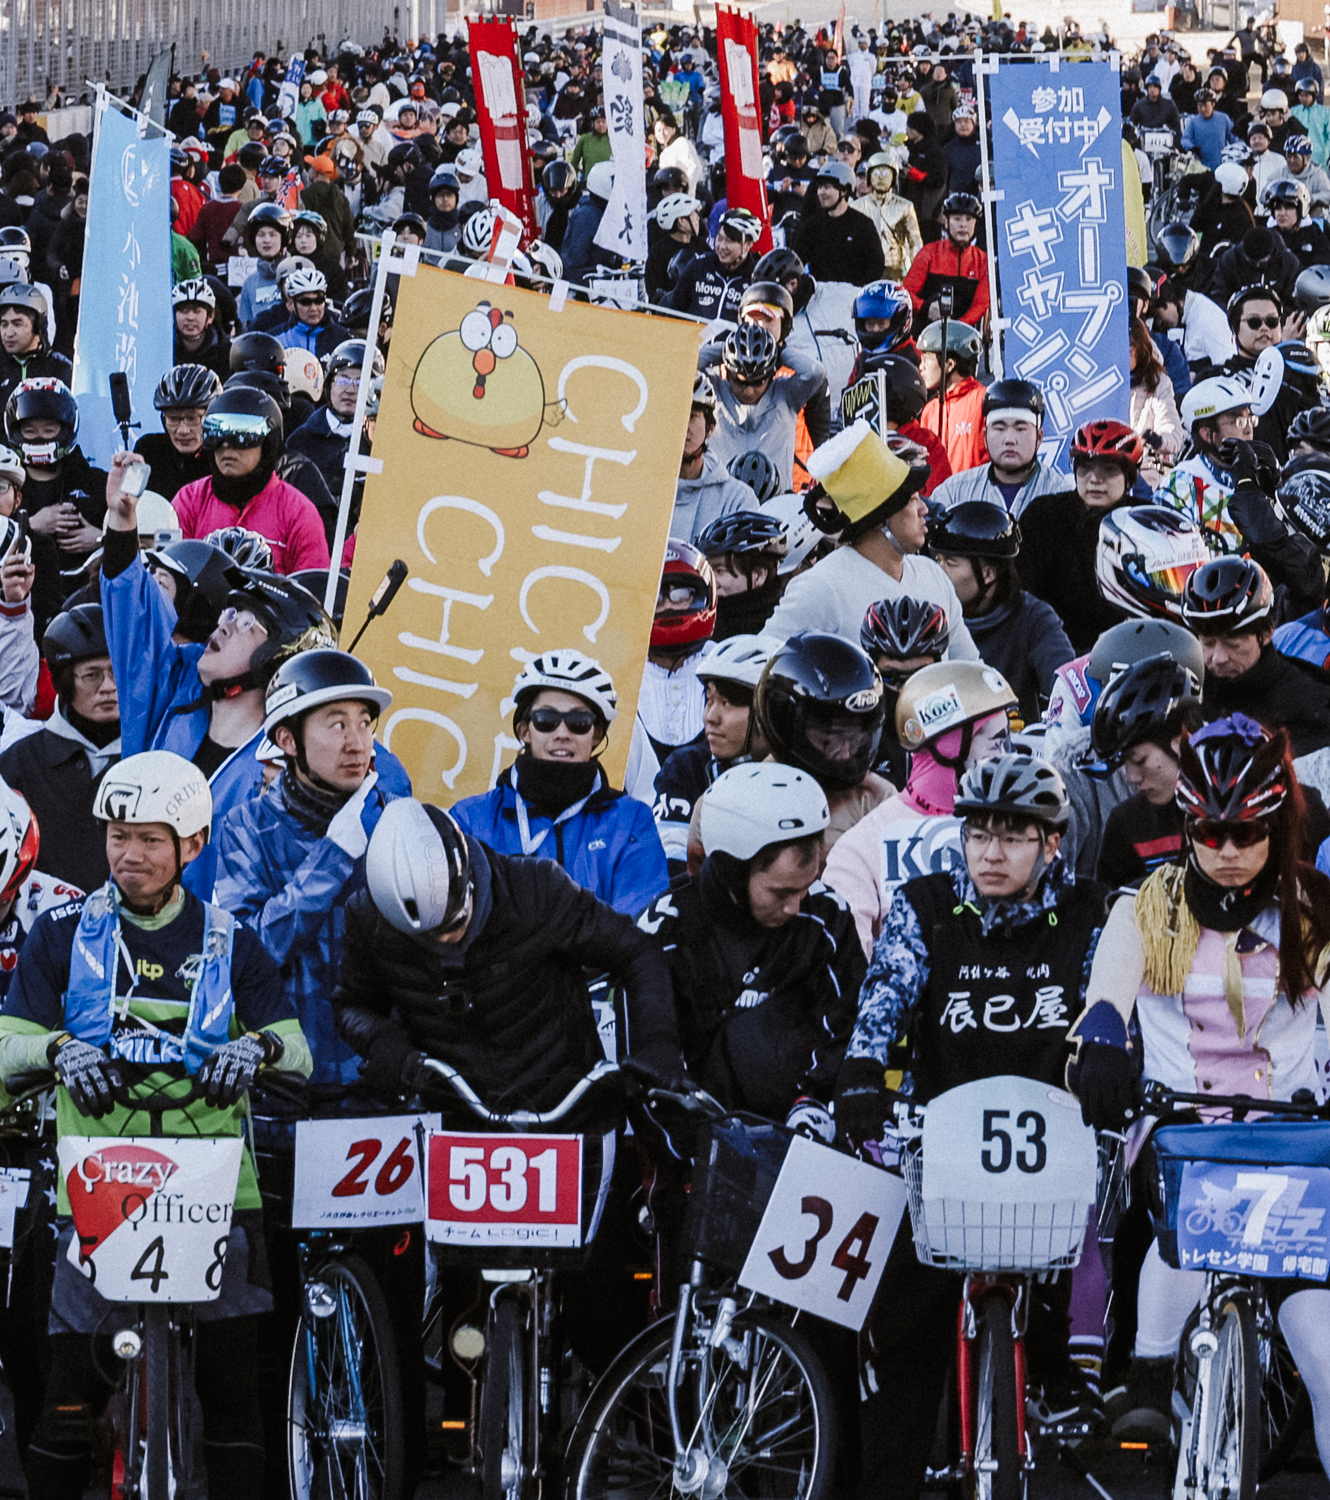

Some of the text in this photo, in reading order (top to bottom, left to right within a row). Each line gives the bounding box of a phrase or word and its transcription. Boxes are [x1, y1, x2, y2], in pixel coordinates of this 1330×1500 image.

[1030, 86, 1084, 112] 参加
[1019, 117, 1100, 146] 受付中
[695, 281, 722, 297] Move
[1057, 156, 1125, 417] オープン
[136, 959, 164, 981] itp
[980, 1109, 1048, 1173] 53
[76, 1152, 175, 1193] Crazy
[331, 1136, 415, 1198] 26
[449, 1146, 557, 1212] 531
[121, 1192, 233, 1231] Officer
[1236, 1172, 1289, 1247] 7
[444, 1226, 481, 1239] チーム
[767, 1195, 880, 1301] 34
[1181, 1248, 1269, 1273] トレセン学園
